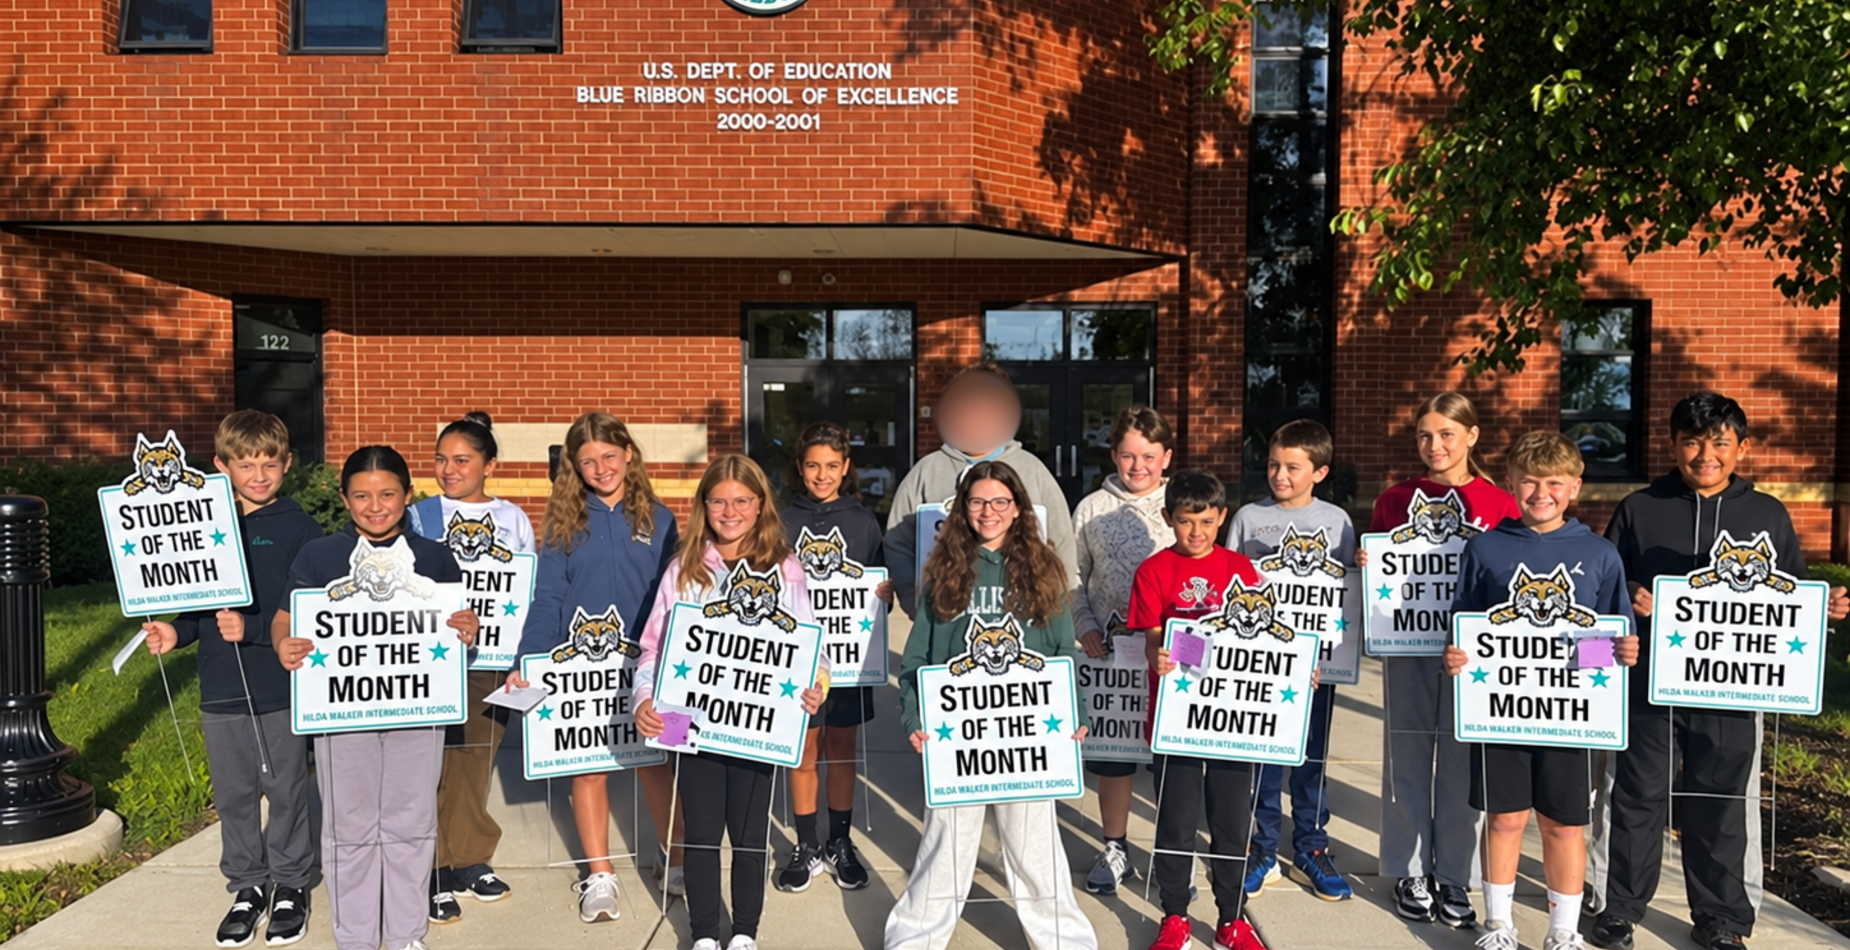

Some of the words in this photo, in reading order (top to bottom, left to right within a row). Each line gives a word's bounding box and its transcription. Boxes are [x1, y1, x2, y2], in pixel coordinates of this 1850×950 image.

[643, 62, 678, 79] U.S.
[686, 62, 741, 79] DEPT.
[749, 62, 774, 79] OF
[784, 62, 892, 79] EDUCATION
[576, 87, 624, 104] BLUE
[634, 87, 705, 104] RIBBON
[714, 87, 793, 104] SCHOOL
[802, 87, 828, 104] OF
[837, 87, 959, 105] EXCELLENCE
[716, 113, 821, 130] 2000-2001
[261, 334, 290, 350] 122
[119, 498, 215, 530] STUDENT
[140, 534, 164, 556] OF
[167, 529, 205, 552] THE
[140, 558, 219, 589] MONTH
[1381, 551, 1465, 576] STUDE
[461, 570, 517, 592] DENT
[1401, 582, 1426, 602] OF
[1431, 581, 1458, 602] TH
[467, 598, 496, 618] HE
[1276, 582, 1348, 609] UDENT
[315, 609, 442, 639] STUDENT
[1291, 610, 1328, 632] THE
[1392, 608, 1449, 632] MON
[1674, 595, 1804, 628] STUDENT
[337, 644, 367, 668] OF
[375, 642, 420, 666] THE
[685, 624, 799, 669] STUDENT
[1476, 631, 1575, 661] STUDE
[1693, 630, 1725, 652] OF
[1731, 632, 1779, 655] THE
[1212, 645, 1298, 677] UDENT
[1684, 656, 1787, 688] MONTH
[328, 673, 430, 704] MONTH
[542, 668, 638, 696] STUDEN
[698, 662, 726, 687] OF
[732, 667, 773, 696] THE
[1078, 664, 1148, 689] STUDE
[1199, 676, 1227, 698] OF
[1233, 679, 1273, 703] THE
[1498, 665, 1528, 687] OF
[1533, 667, 1581, 689] THE
[560, 699, 586, 720] OF
[591, 695, 629, 717] THE
[939, 680, 1053, 712] STUDENT
[1093, 693, 1114, 710] OF
[1488, 692, 1591, 722] MONTH
[1658, 687, 1682, 697] HILDA
[1683, 688, 1716, 699] WALKER
[1717, 690, 1776, 703] INTERMEDIATE
[1777, 694, 1811, 705] SCHOOL
[303, 712, 328, 722] HILDA
[329, 709, 363, 721] WALKER
[365, 706, 424, 718] INTERMEDIATE
[426, 704, 458, 715] SCHOOL
[684, 690, 776, 734] MONTH
[1186, 703, 1277, 737] MONTH
[554, 722, 637, 752] MONTH
[961, 718, 988, 741] OF
[994, 714, 1037, 738] THE
[1089, 715, 1147, 740] MONT
[1464, 723, 1488, 733] HILDA
[1489, 725, 1522, 735] WALKER
[1523, 726, 1582, 738] INTERMEDIATE
[1584, 729, 1617, 740] SCHOOL
[1184, 737, 1214, 748] WALKER
[1269, 744, 1297, 755] SCHOOL
[955, 745, 1048, 777] MONTH
[934, 786, 956, 796] HILDA
[957, 784, 990, 795] WALKER
[991, 780, 1044, 792] INTERMEDIATE
[1045, 778, 1075, 789] SCHOOL
